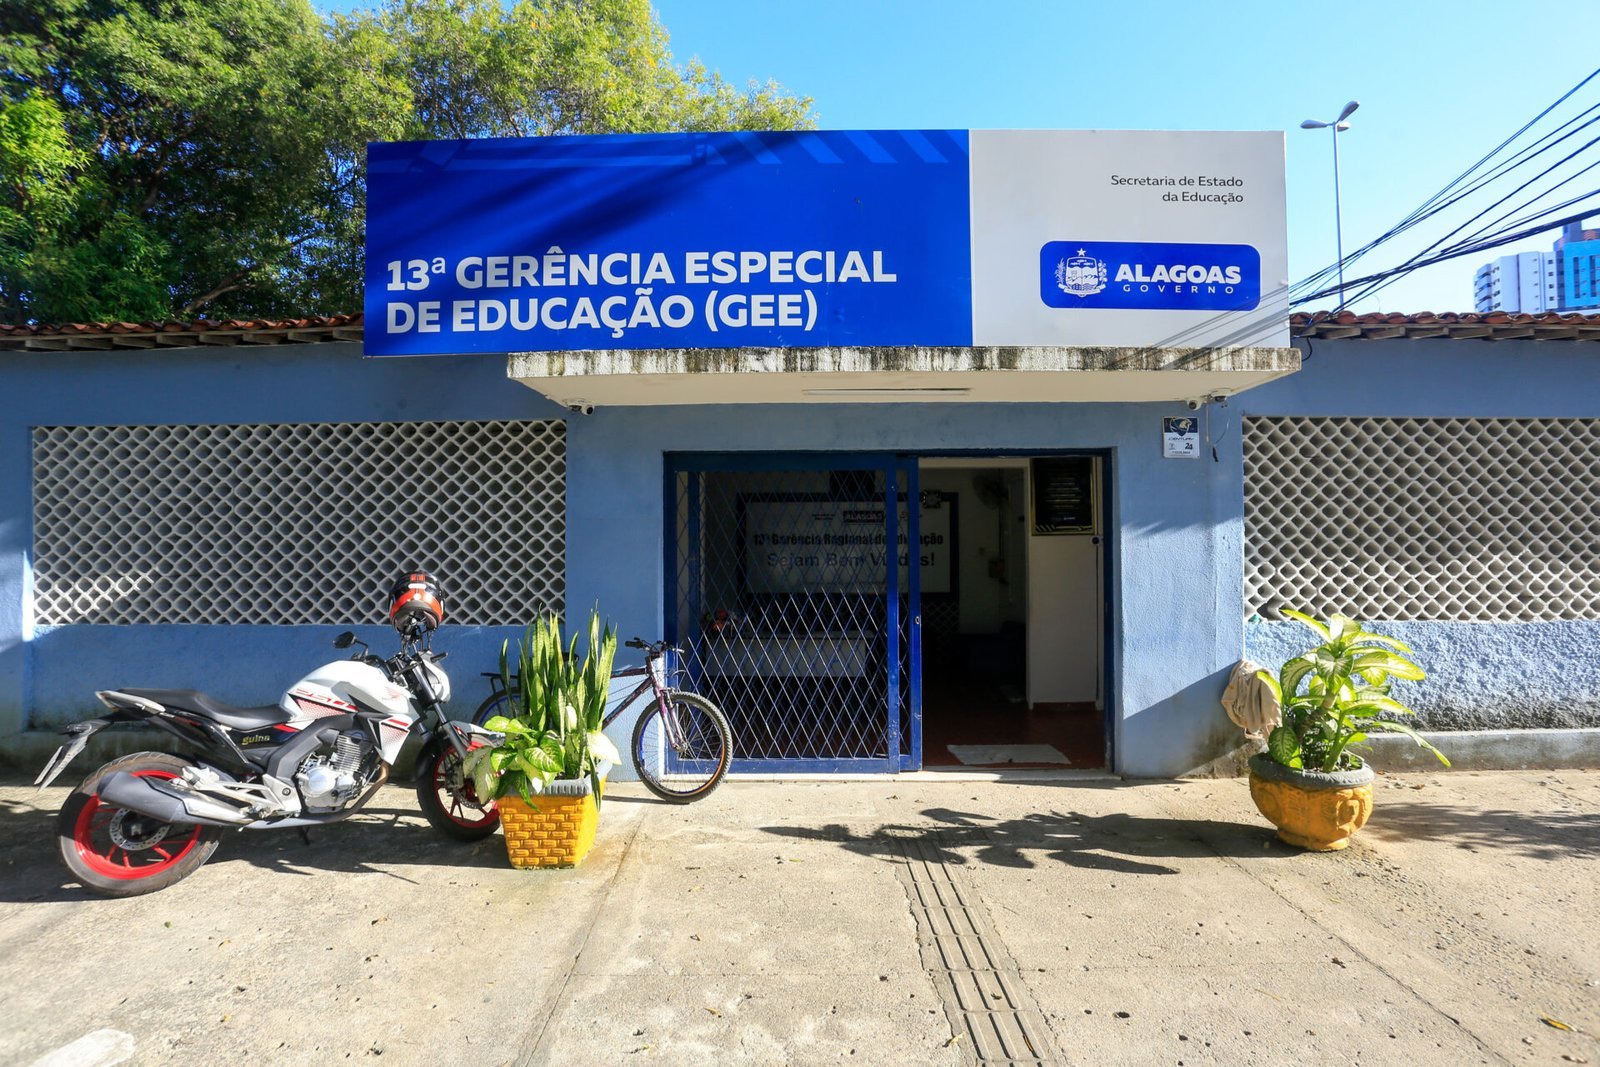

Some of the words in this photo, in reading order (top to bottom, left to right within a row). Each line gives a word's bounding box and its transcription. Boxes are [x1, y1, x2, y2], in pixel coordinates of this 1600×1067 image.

[1111, 174, 1176, 186] Secretaria
[1178, 175, 1195, 186] de
[1198, 176, 1244, 187] Estado
[1163, 191, 1179, 202] da
[1182, 191, 1244, 205] Educação
[387, 257, 446, 291] 13ª
[455, 246, 676, 289] GERÊNCIA
[685, 250, 898, 284] ESPECIAL
[1114, 263, 1242, 285] ALAGOAS
[1122, 284, 1234, 294] GOVERNO
[387, 302, 441, 334] DE
[452, 287, 695, 339] EDUCAÇÃO
[704, 290, 818, 332] (GEE)
[767, 552, 820, 569] Sejam
